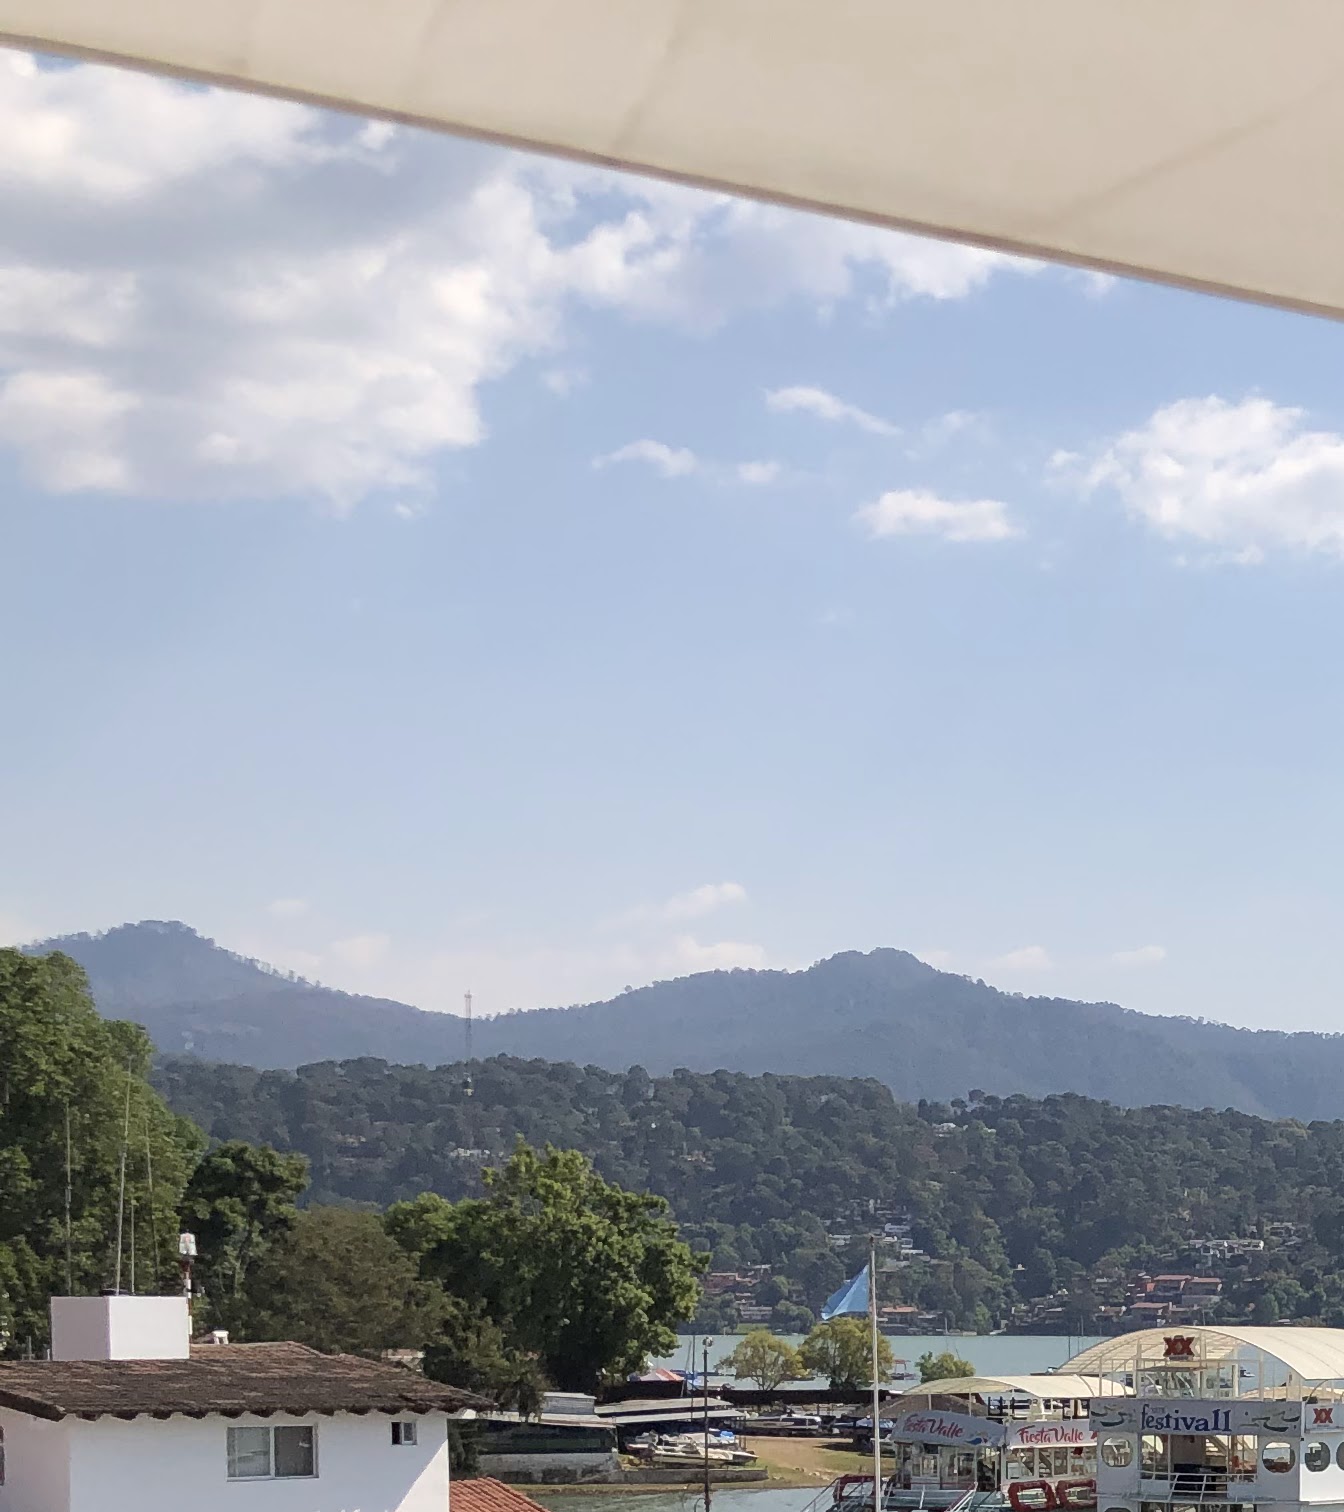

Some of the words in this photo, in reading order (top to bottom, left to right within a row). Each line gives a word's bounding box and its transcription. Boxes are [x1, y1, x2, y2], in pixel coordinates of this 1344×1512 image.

[1141, 1403, 1232, 1432] festivall
[1017, 1424, 1050, 1444] Fiesta
[1049, 1427, 1084, 1444] Valle
